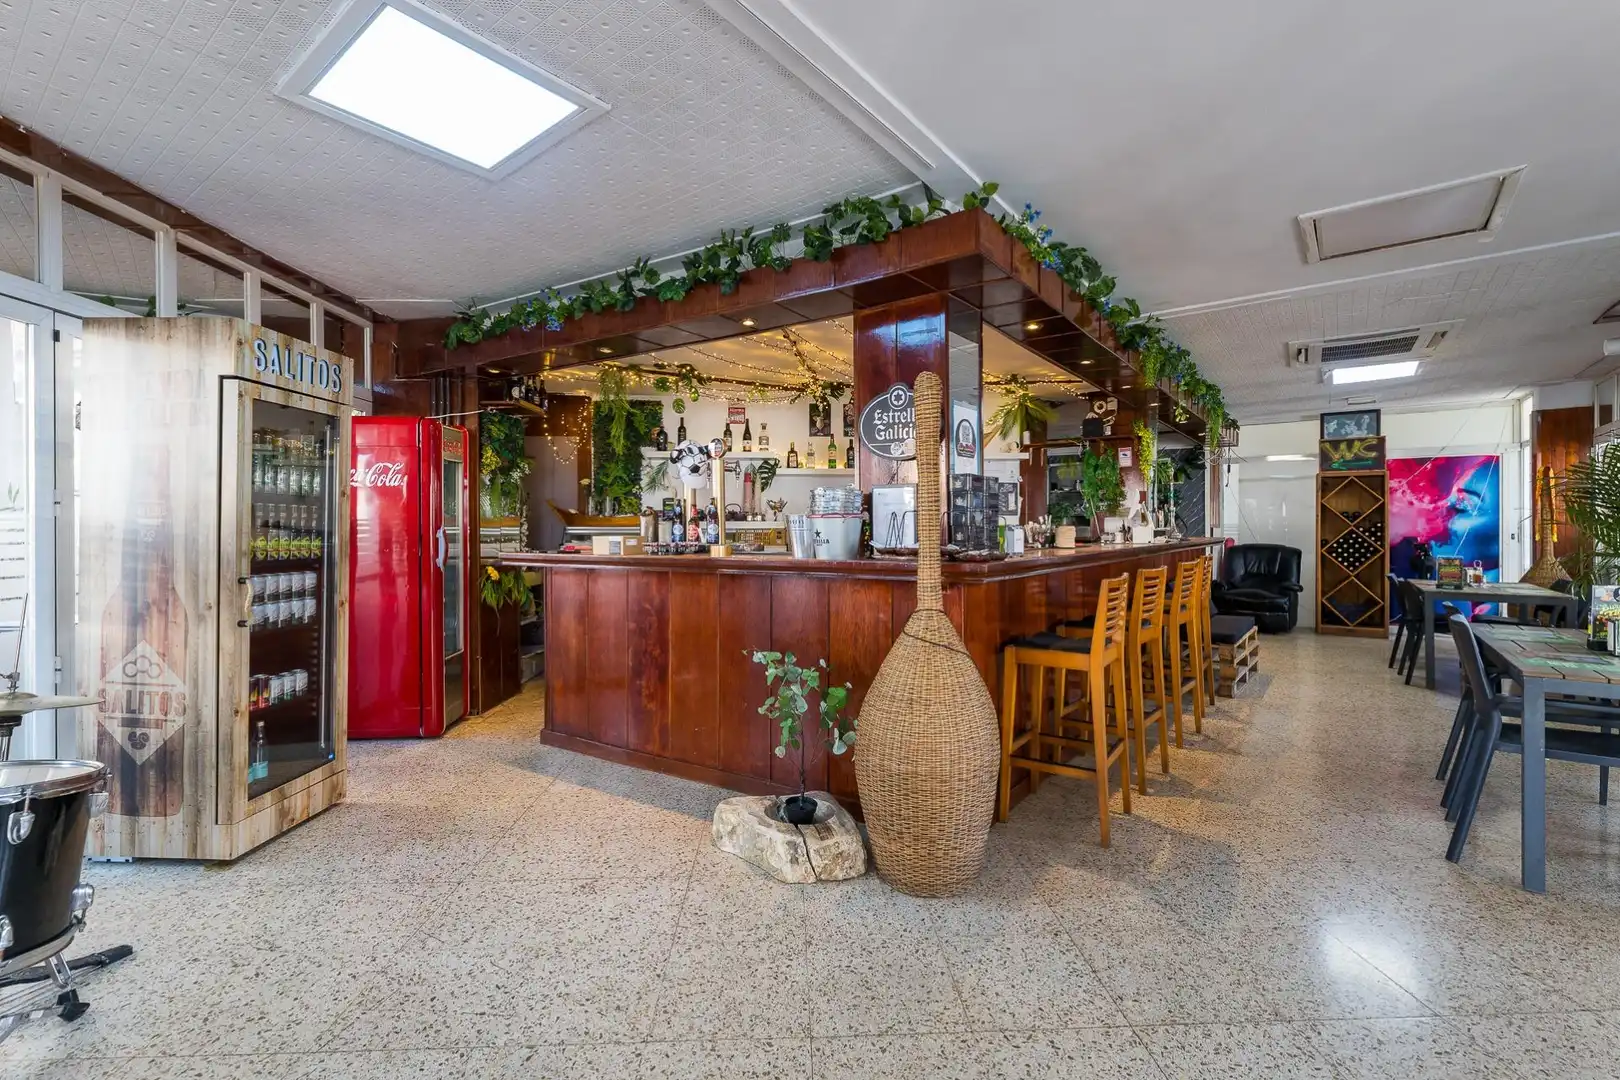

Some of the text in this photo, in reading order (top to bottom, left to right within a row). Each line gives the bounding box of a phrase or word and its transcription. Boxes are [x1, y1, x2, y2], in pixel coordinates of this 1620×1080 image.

[254, 338, 342, 393] SALITOS
[873, 407, 915, 425] Estrell
[1321, 438, 1378, 460] WC
[350, 462, 404, 488] ca-Cola
[98, 688, 187, 718] SALITOS
